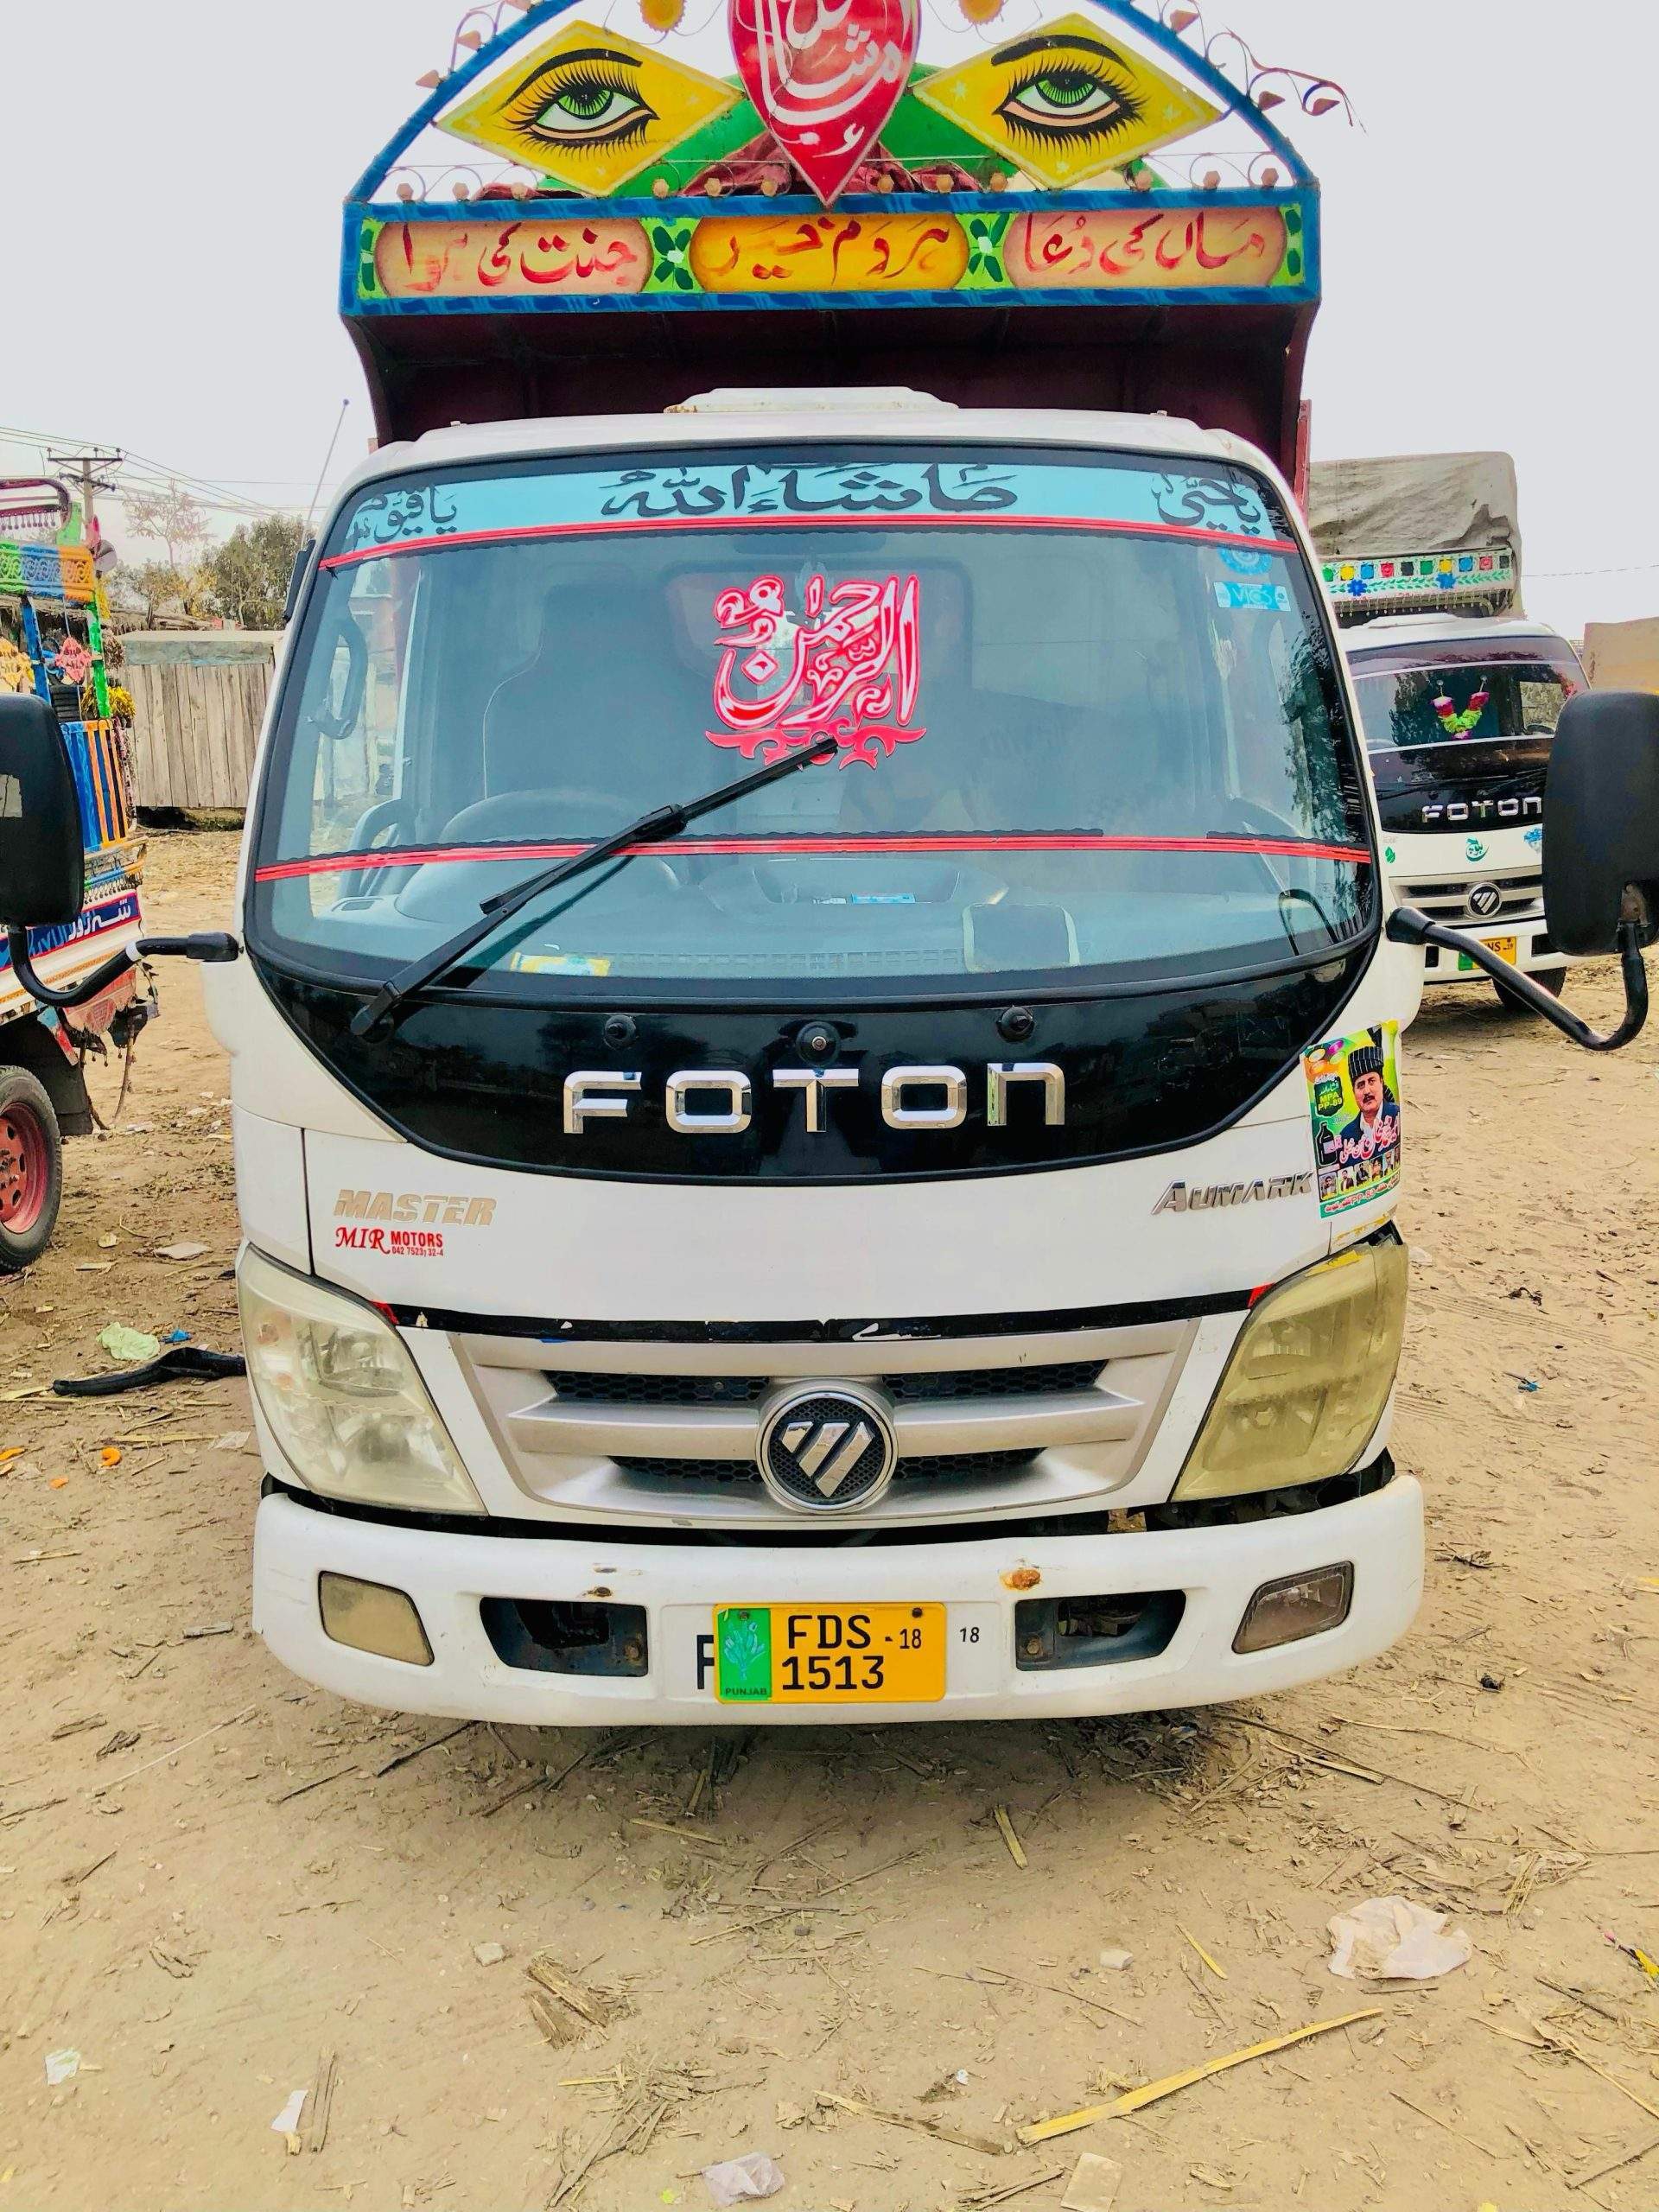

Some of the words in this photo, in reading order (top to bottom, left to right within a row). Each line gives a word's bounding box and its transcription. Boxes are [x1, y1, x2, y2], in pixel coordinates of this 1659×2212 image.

[477, 222, 523, 287] کی
[519, 227, 638, 286] جنت
[882, 217, 950, 279] ہر
[1098, 213, 1165, 276] کی
[1155, 212, 1265, 270] ماں
[1421, 796, 1542, 823] FOTON
[563, 1062, 1065, 1135] FOTON
[1319, 1091, 1339, 1103] MPA
[333, 1189, 498, 1226] MASTER
[335, 1227, 391, 1254] MIR
[391, 1230, 443, 1248] MOTORS
[391, 1246, 404, 1255] 042
[787, 1615, 872, 1649] FDS
[959, 1627, 980, 1643] 18
[781, 1656, 884, 1690] 1513
[725, 1688, 767, 1696] PUNJAB
